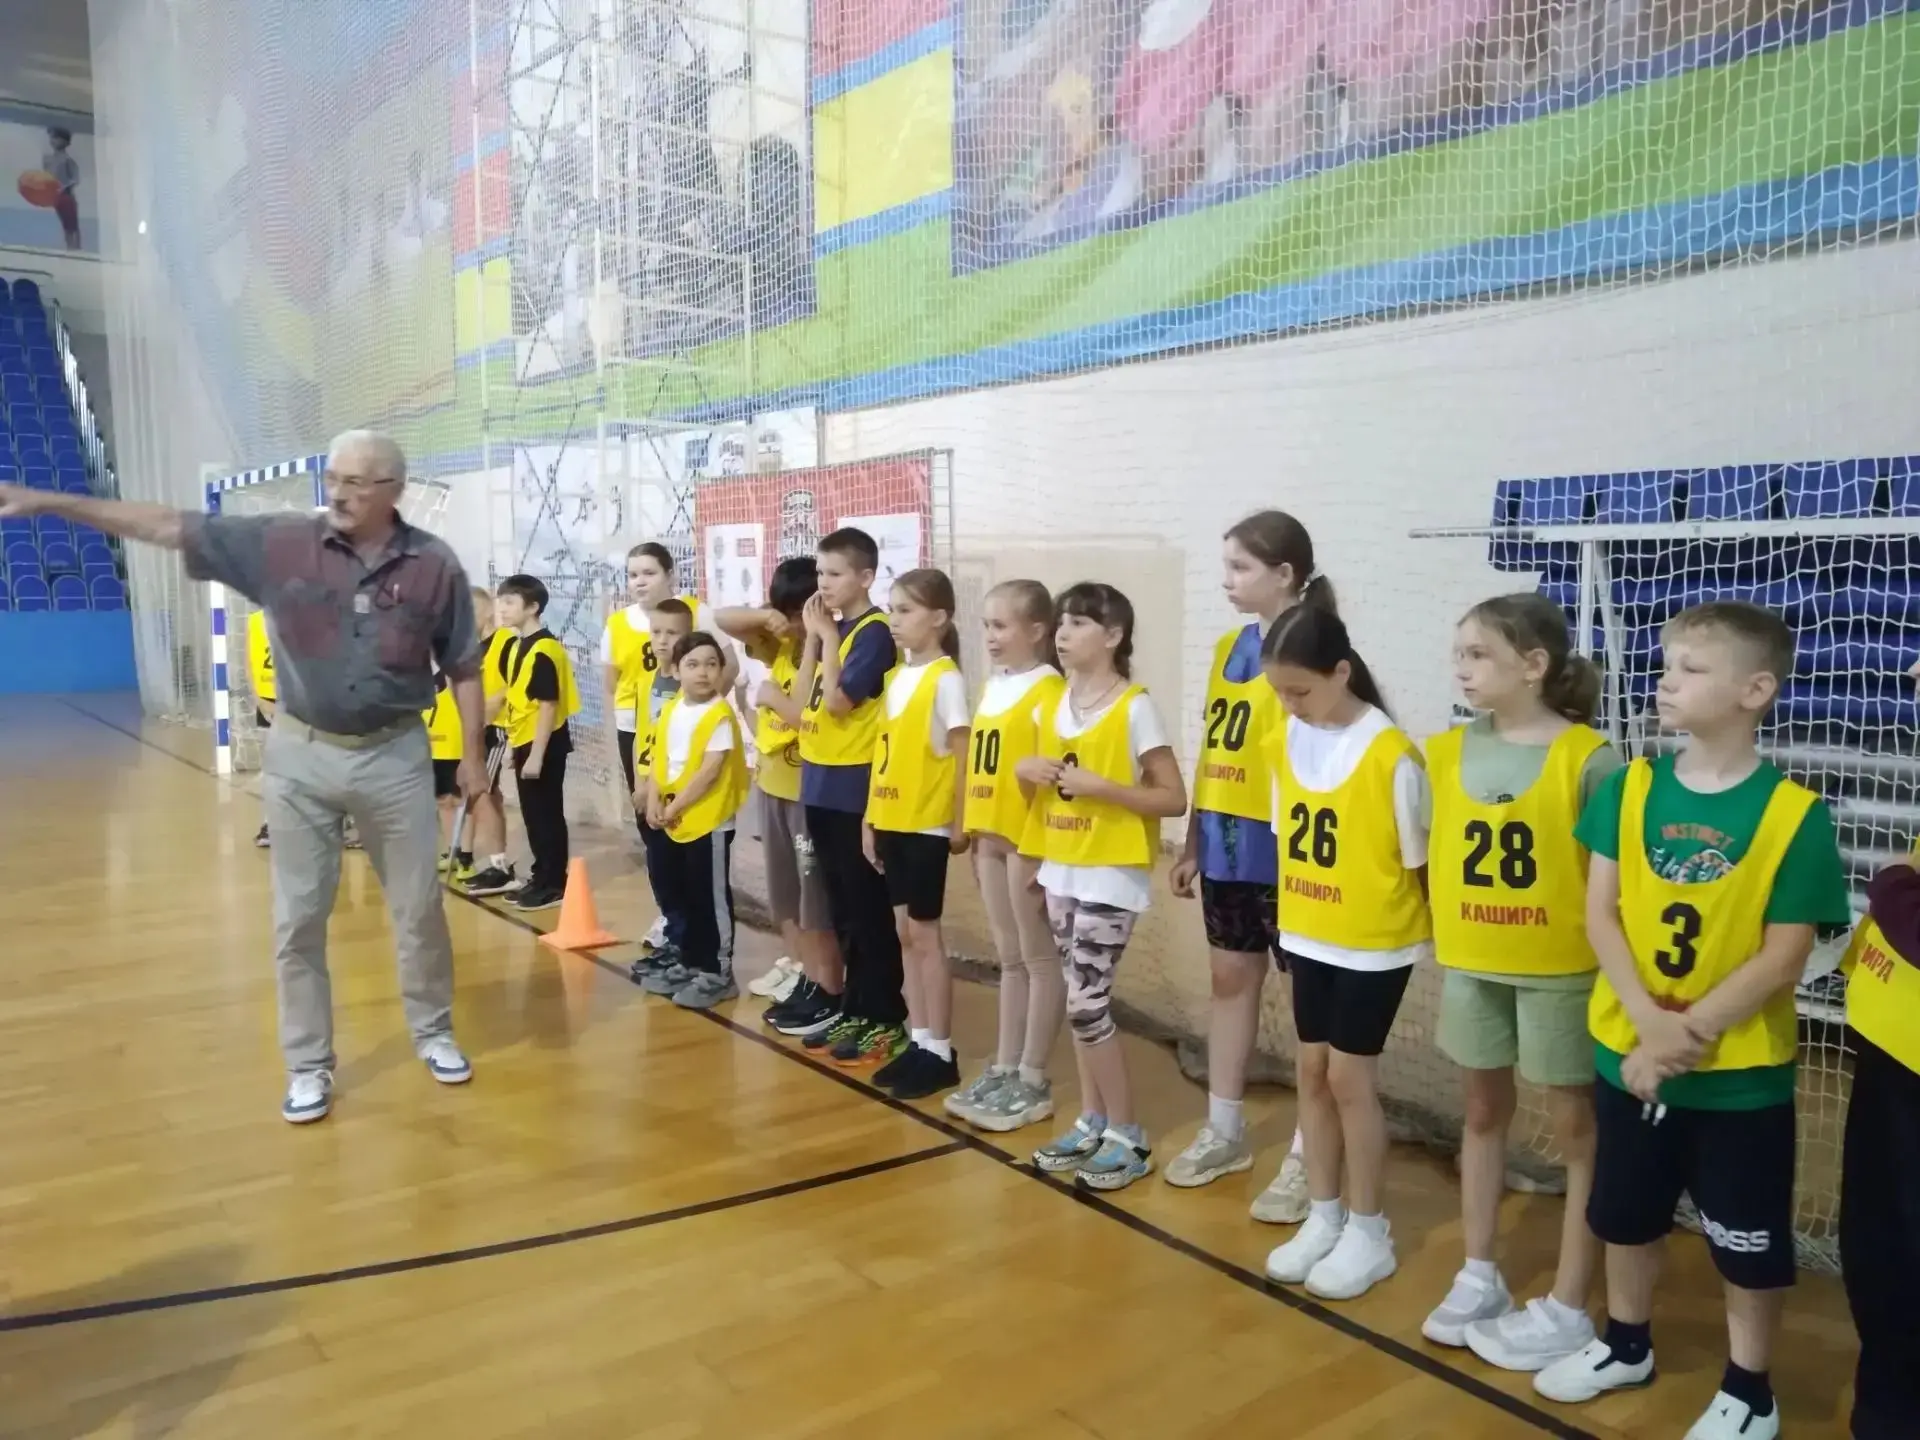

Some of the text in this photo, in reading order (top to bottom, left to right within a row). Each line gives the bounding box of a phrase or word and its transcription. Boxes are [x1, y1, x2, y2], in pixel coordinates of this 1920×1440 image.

[972, 729, 1001, 775] 10
[1206, 697, 1251, 752] 20
[1288, 802, 1338, 868] 26
[1463, 819, 1537, 889] 28
[1284, 874, 1343, 905] КАШИРА
[1460, 900, 1549, 927] КАШИРА
[1655, 901, 1703, 979] 3
